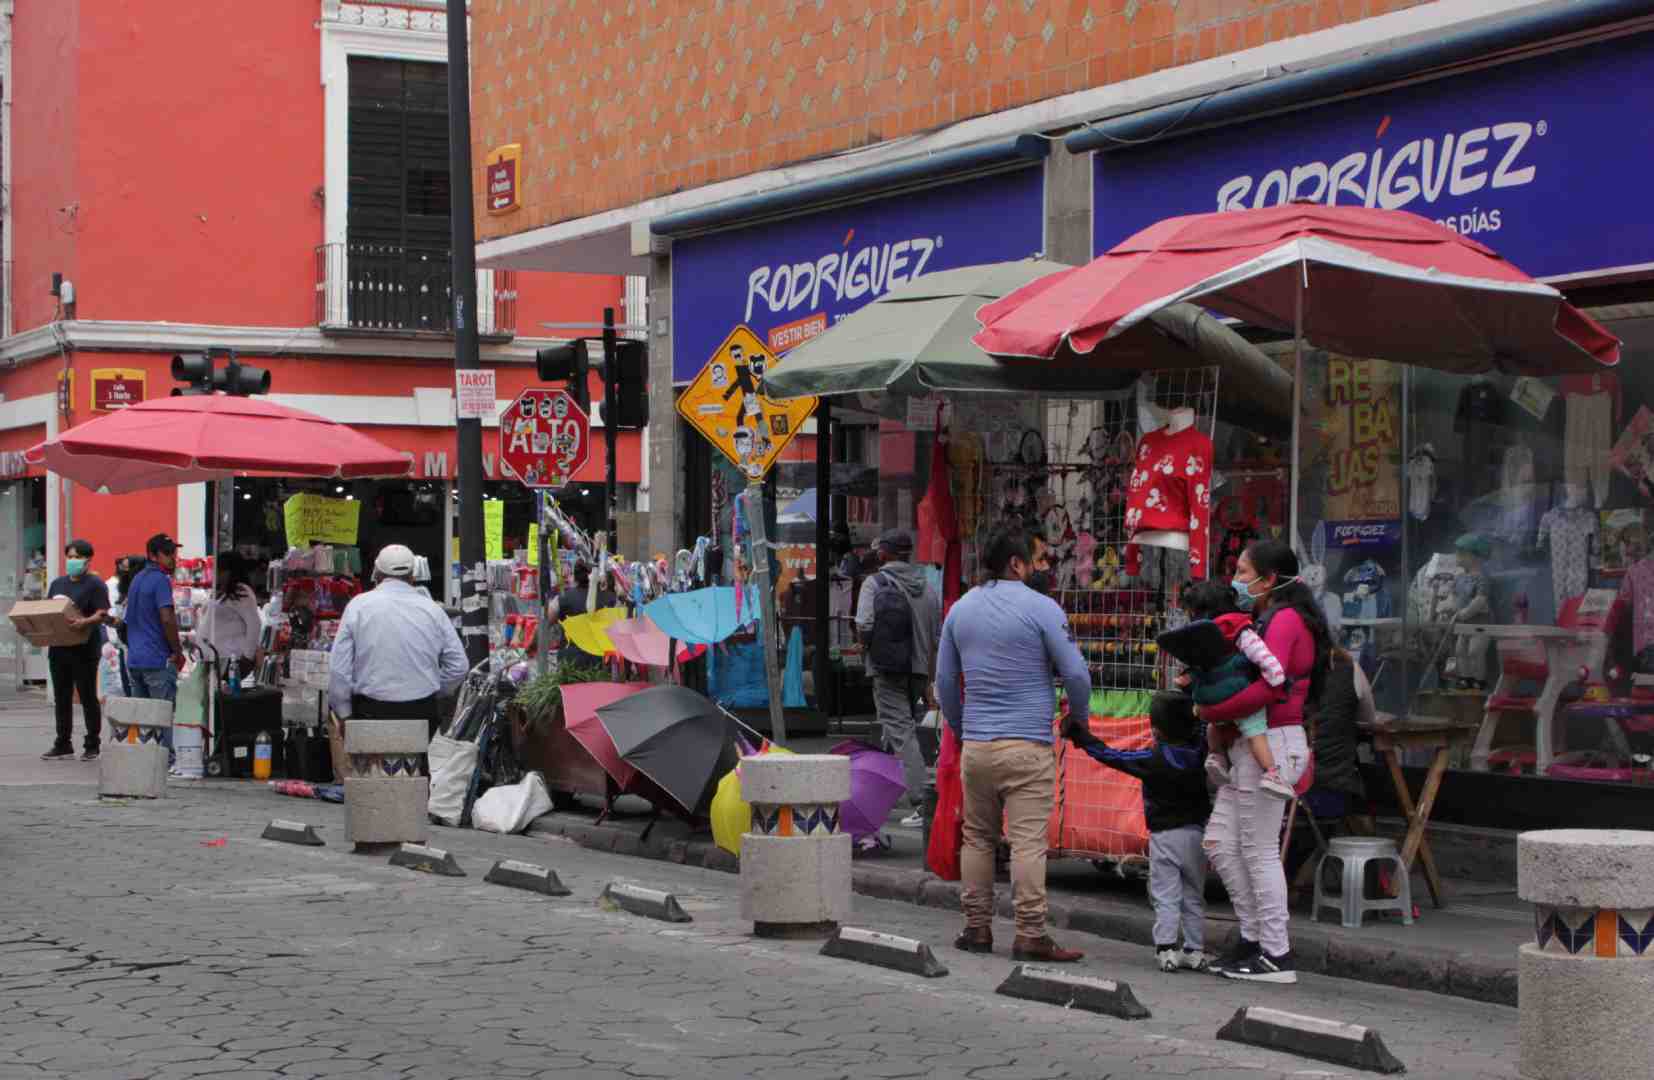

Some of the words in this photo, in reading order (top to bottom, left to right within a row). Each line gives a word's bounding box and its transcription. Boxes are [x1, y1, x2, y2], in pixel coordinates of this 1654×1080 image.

[1460, 207, 1501, 234] DÍAS
[745, 228, 934, 322] RODRÍGUEZ
[772, 326, 802, 347] VESTIR
[803, 319, 825, 338] BIEN
[459, 374, 493, 386] TAROT
[508, 417, 581, 459] ALTO
[1353, 402, 1393, 445] BA
[1328, 447, 1379, 494] JAS
